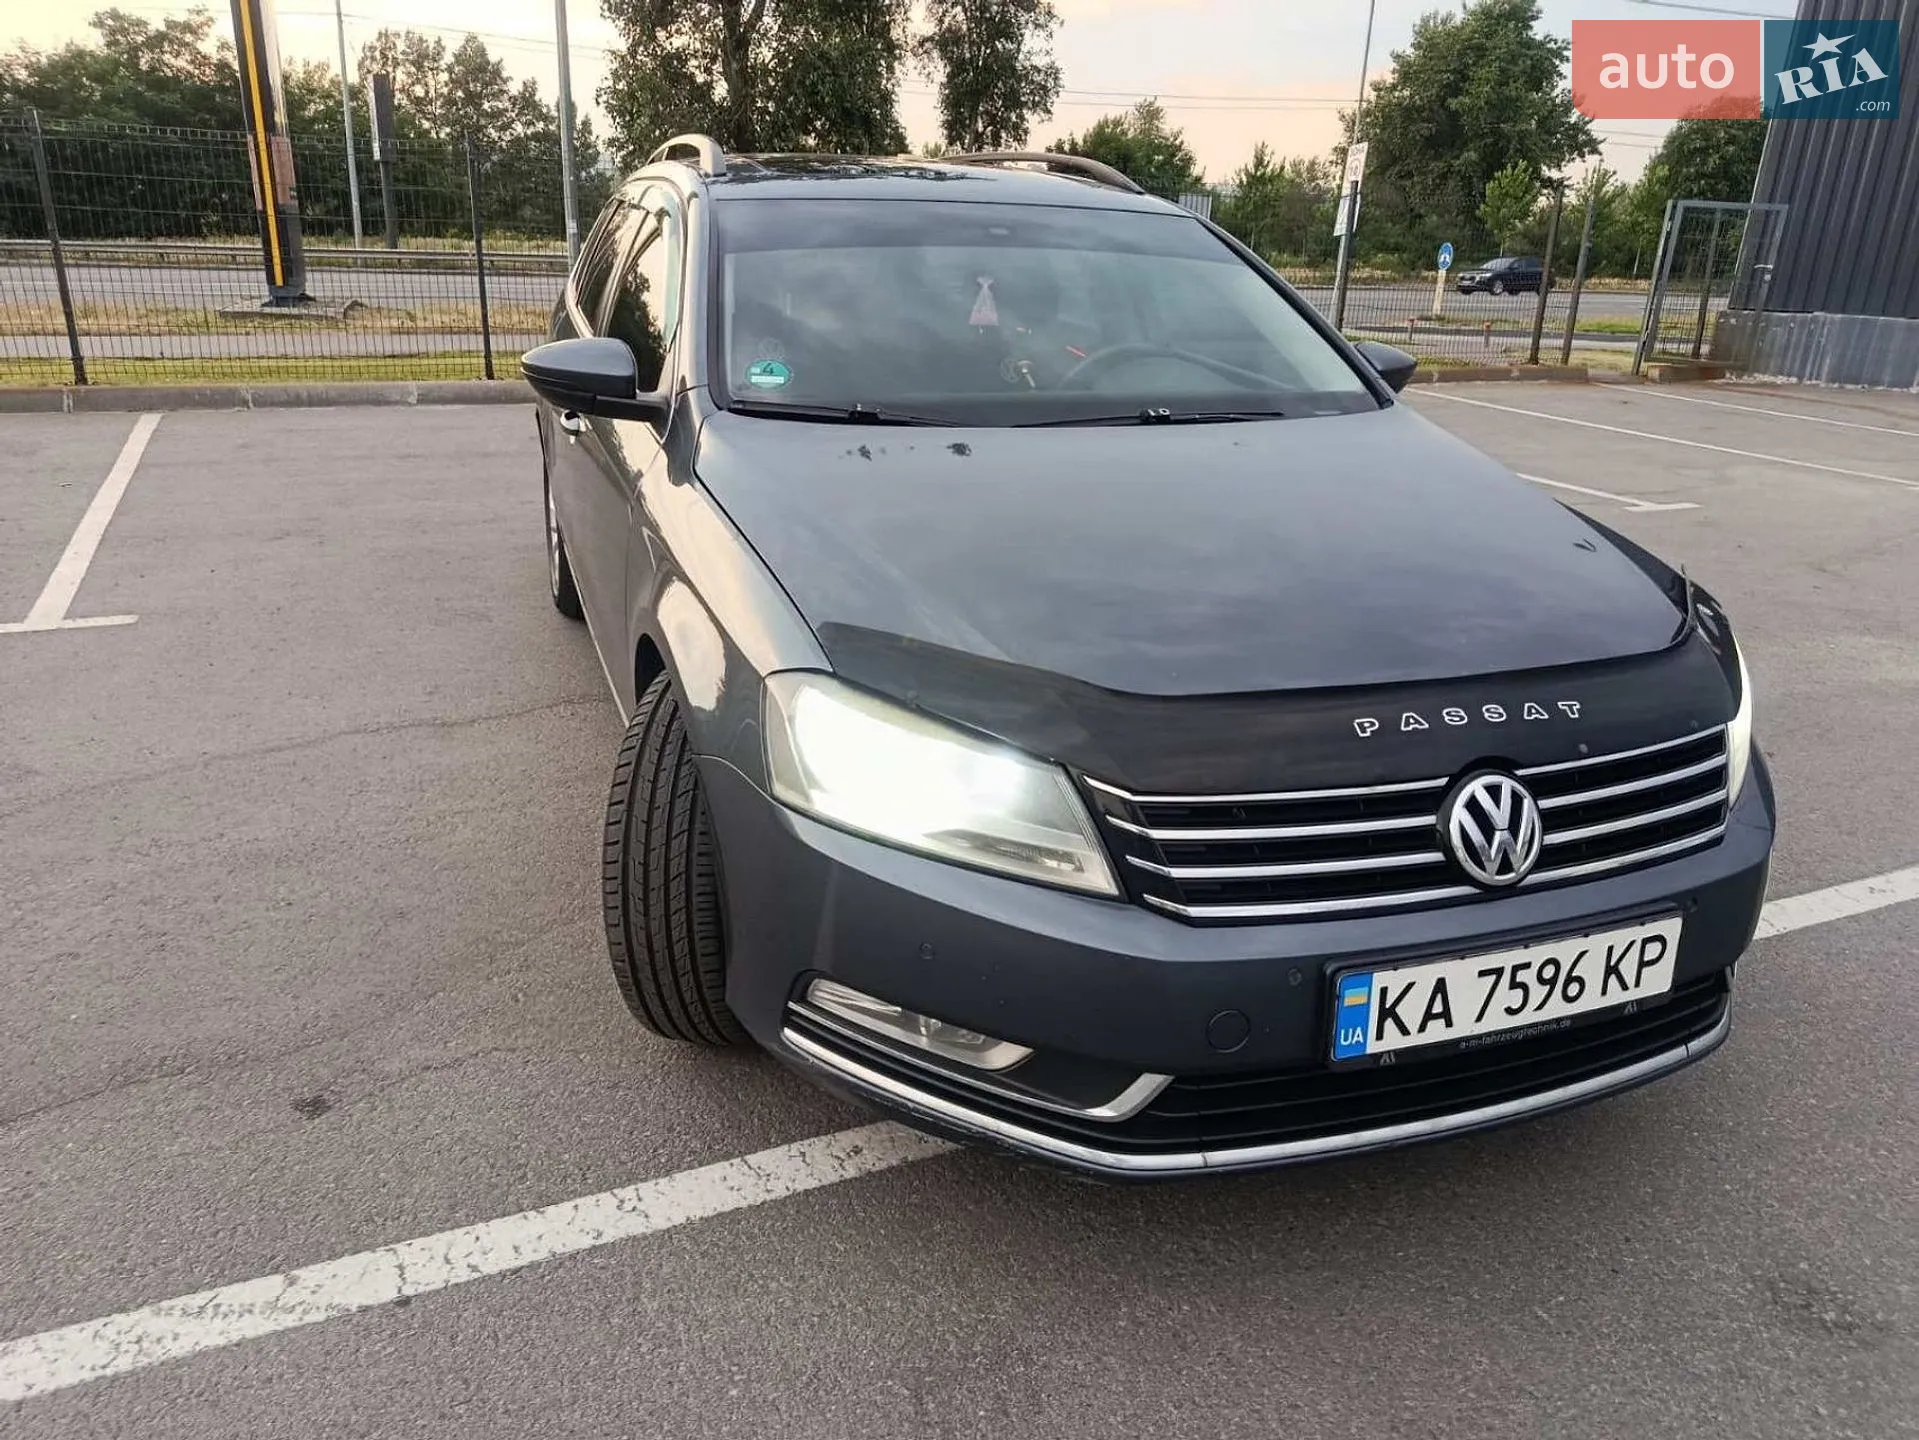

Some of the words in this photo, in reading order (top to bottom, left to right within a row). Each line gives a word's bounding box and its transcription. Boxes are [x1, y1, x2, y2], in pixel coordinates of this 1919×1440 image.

[1353, 701, 1580, 736] PASSAT
[1375, 977, 1453, 1041] KA
[1474, 950, 1589, 1022] 7596
[1601, 933, 1668, 996] KP
[1339, 1027, 1364, 1046] UA
